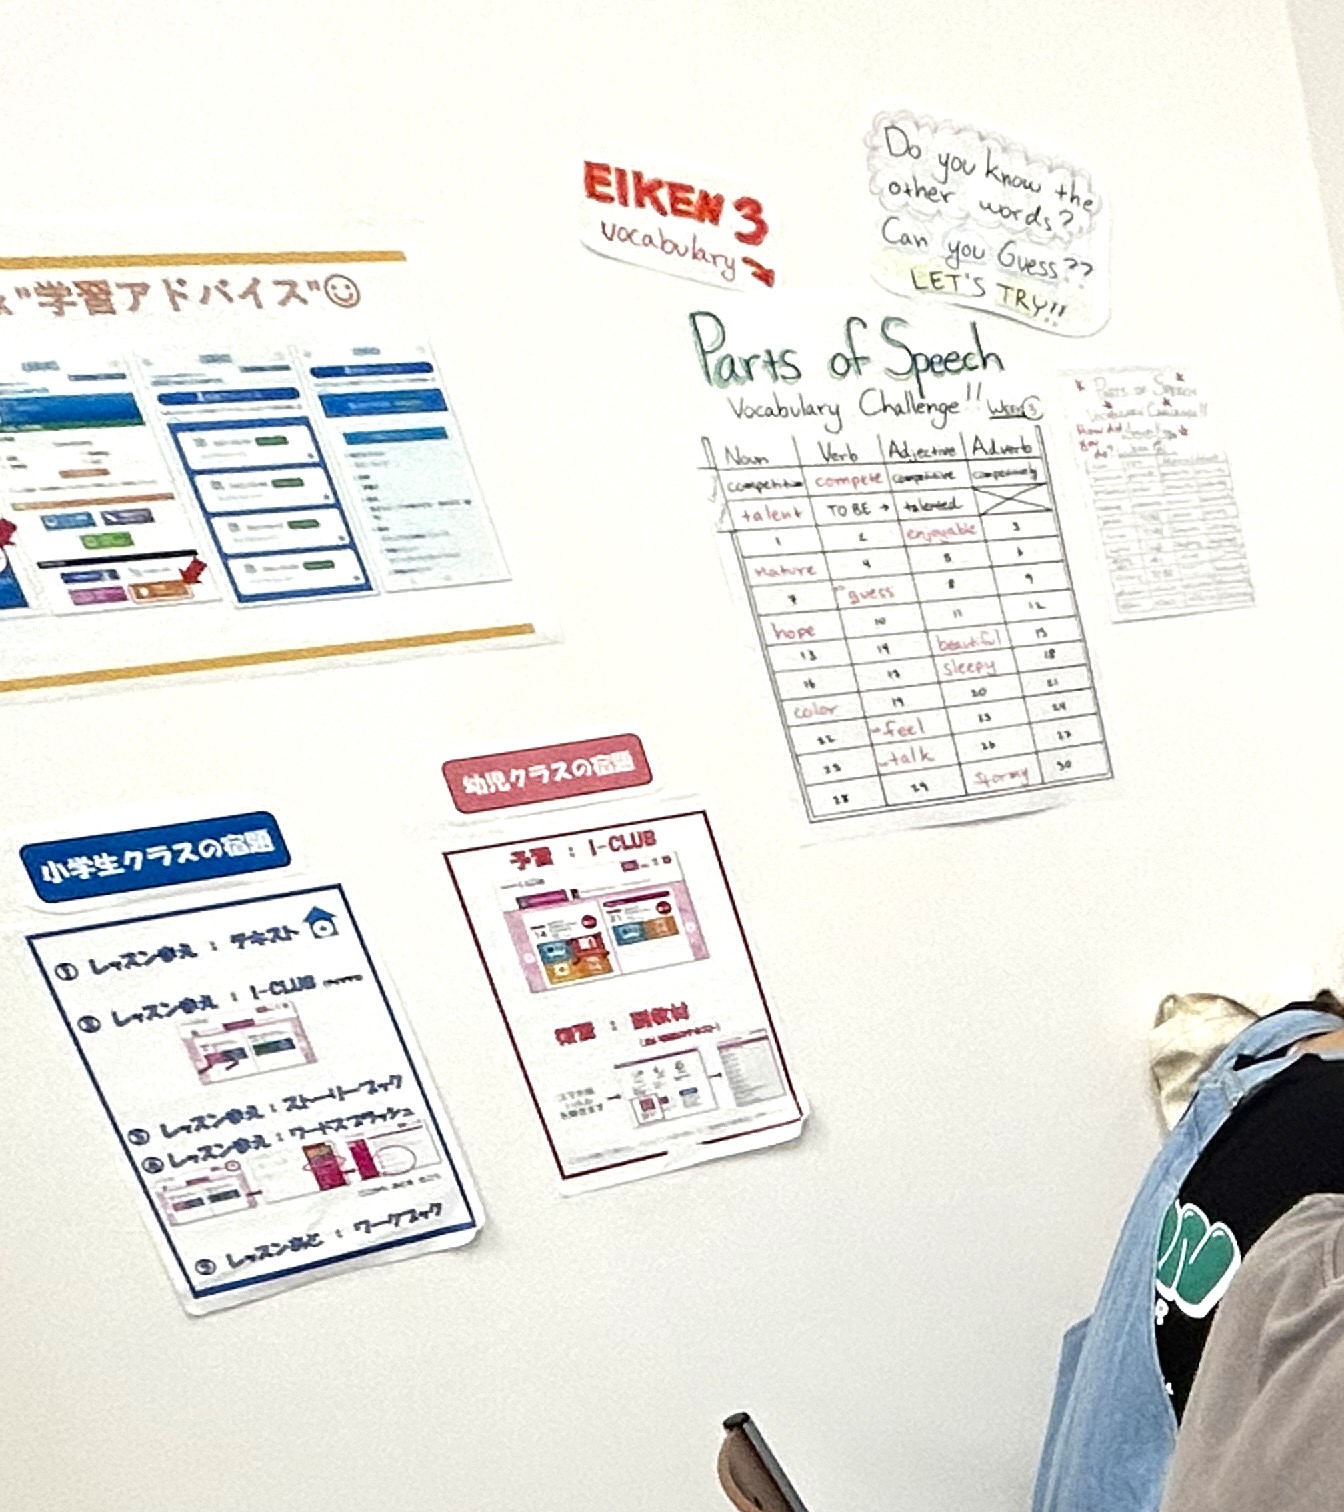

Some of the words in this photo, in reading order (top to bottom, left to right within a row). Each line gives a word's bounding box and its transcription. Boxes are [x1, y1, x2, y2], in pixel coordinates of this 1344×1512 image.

[884, 125, 921, 160] Do
[938, 149, 976, 185] you
[986, 148, 1042, 194] know
[1054, 178, 1093, 212] the
[584, 161, 724, 226] EIKEN
[734, 197, 768, 245] 3
[889, 176, 952, 203] other
[978, 199, 1074, 233] words?
[881, 217, 928, 248] Can
[947, 240, 986, 269] you
[910, 267, 986, 298] LET'S
[688, 310, 802, 389] Parts
[828, 317, 870, 381] of
[880, 317, 1005, 398] Speech
[728, 397, 842, 433] Vocabulary
[817, 441, 858, 462] Verb
[462, 750, 636, 795] 幼児クラスの宿題
[42, 828, 275, 884] 小学生クラスの宿題
[588, 829, 658, 856] I-CLUB
